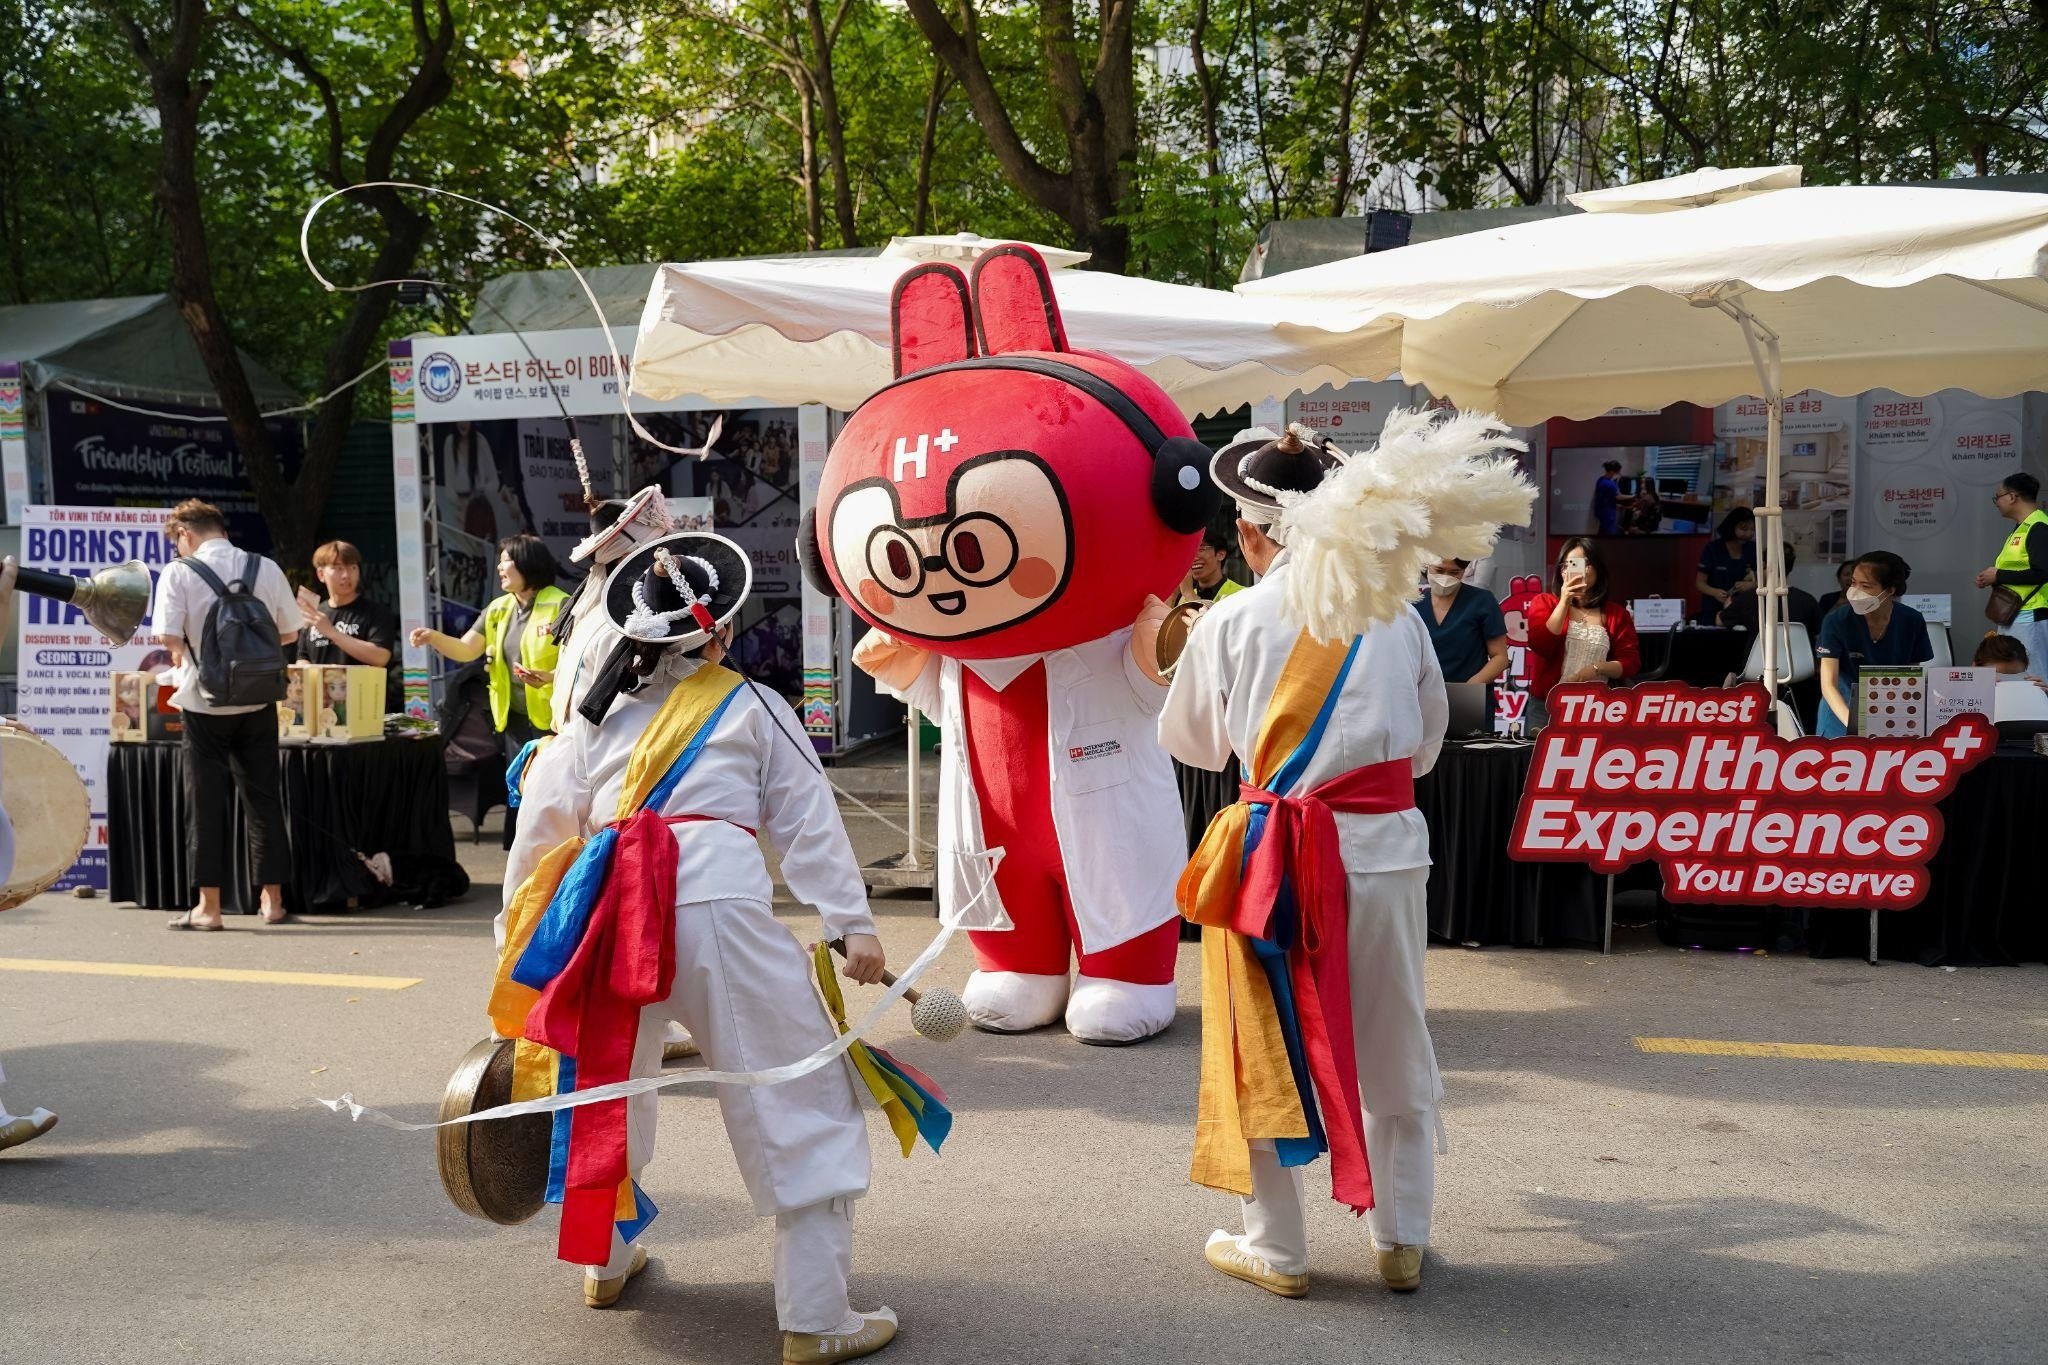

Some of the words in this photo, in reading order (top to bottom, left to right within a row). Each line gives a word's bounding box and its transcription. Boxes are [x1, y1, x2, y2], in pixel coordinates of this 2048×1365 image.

[464, 360, 521, 385] 본스타
[525, 356, 582, 382] 하노이
[529, 384, 548, 398] 보컬
[1299, 401, 1328, 413] 최고의
[1331, 400, 1370, 413] 의료인력
[1799, 400, 1823, 414] 환경
[1873, 402, 1923, 418] 건강검진
[1957, 433, 2012, 449] 외래진료
[73, 436, 173, 482] Friendship
[171, 443, 234, 479] Festival
[1884, 487, 1945, 502] 항노화센터
[50, 509, 66, 521] TÔN
[68, 510, 88, 521] VINH
[752, 549, 789, 565] 하노이
[26, 634, 71, 645] DISCOVERS
[38, 651, 76, 665] SEONG
[79, 651, 109, 665] YEJIN
[26, 670, 53, 679] DANCE
[66, 670, 90, 679] VOCAL
[1560, 695, 1627, 723] The
[1636, 695, 1756, 724] Finest
[62, 727, 82, 736] VOCAL
[1521, 799, 1929, 861] Experience
[1674, 863, 1745, 892] You
[1753, 865, 1915, 896] Deserve
